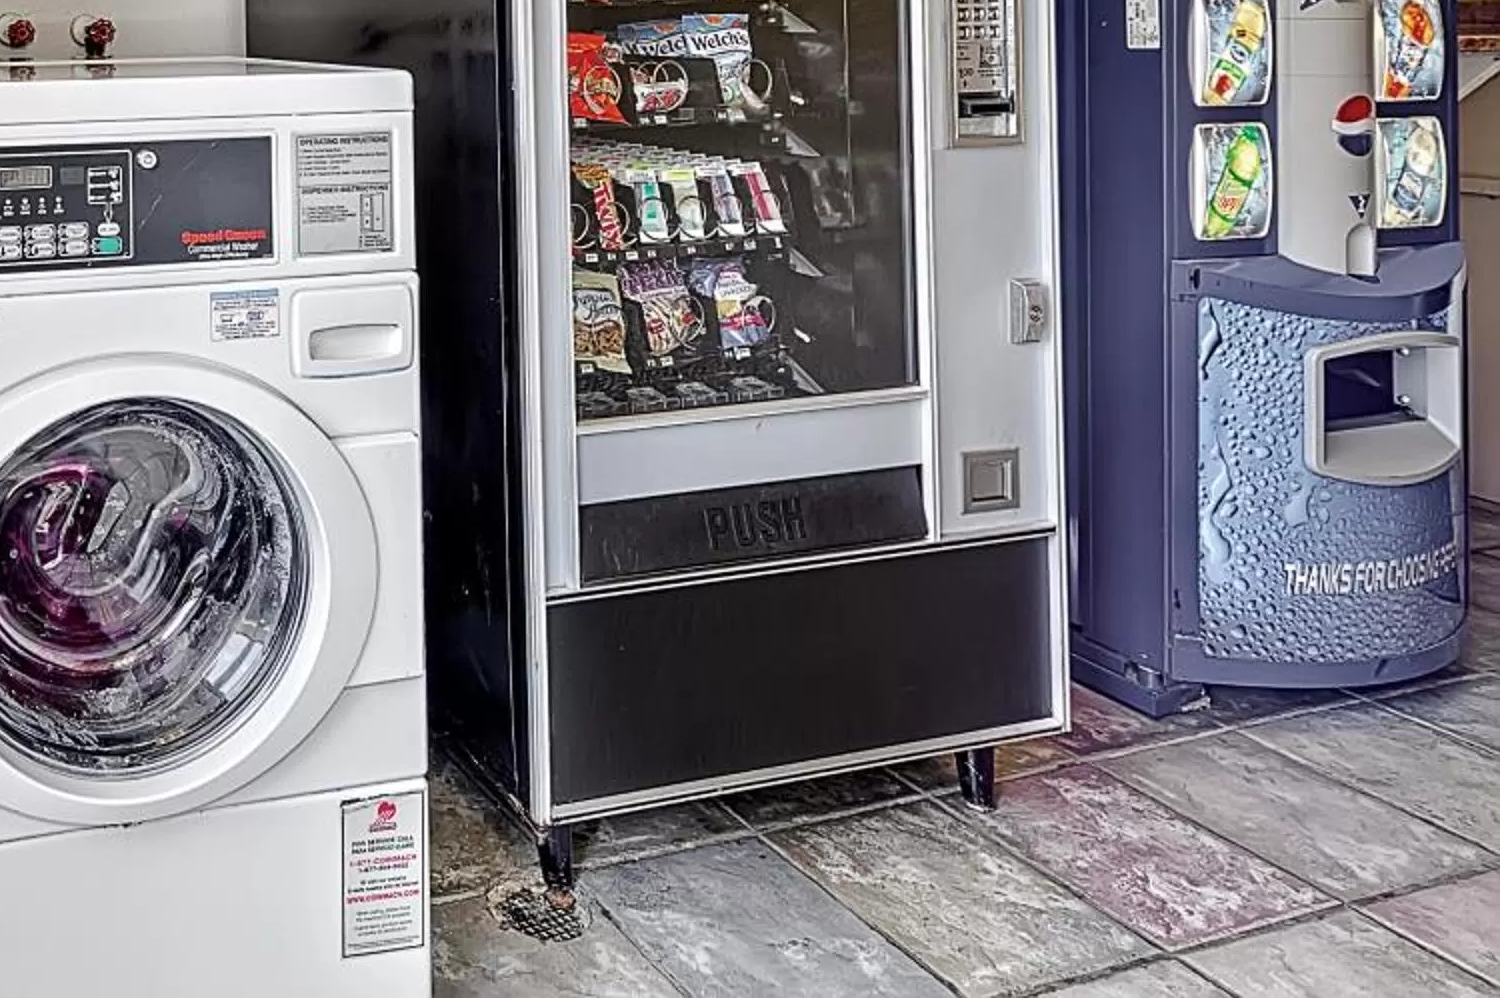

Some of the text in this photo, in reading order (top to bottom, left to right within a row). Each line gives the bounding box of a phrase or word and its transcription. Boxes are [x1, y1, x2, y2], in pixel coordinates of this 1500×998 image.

[691, 30, 749, 51] Welch's
[703, 496, 806, 551] PUSH
[1284, 561, 1351, 595] THANKS
[1354, 560, 1386, 593] FOR
